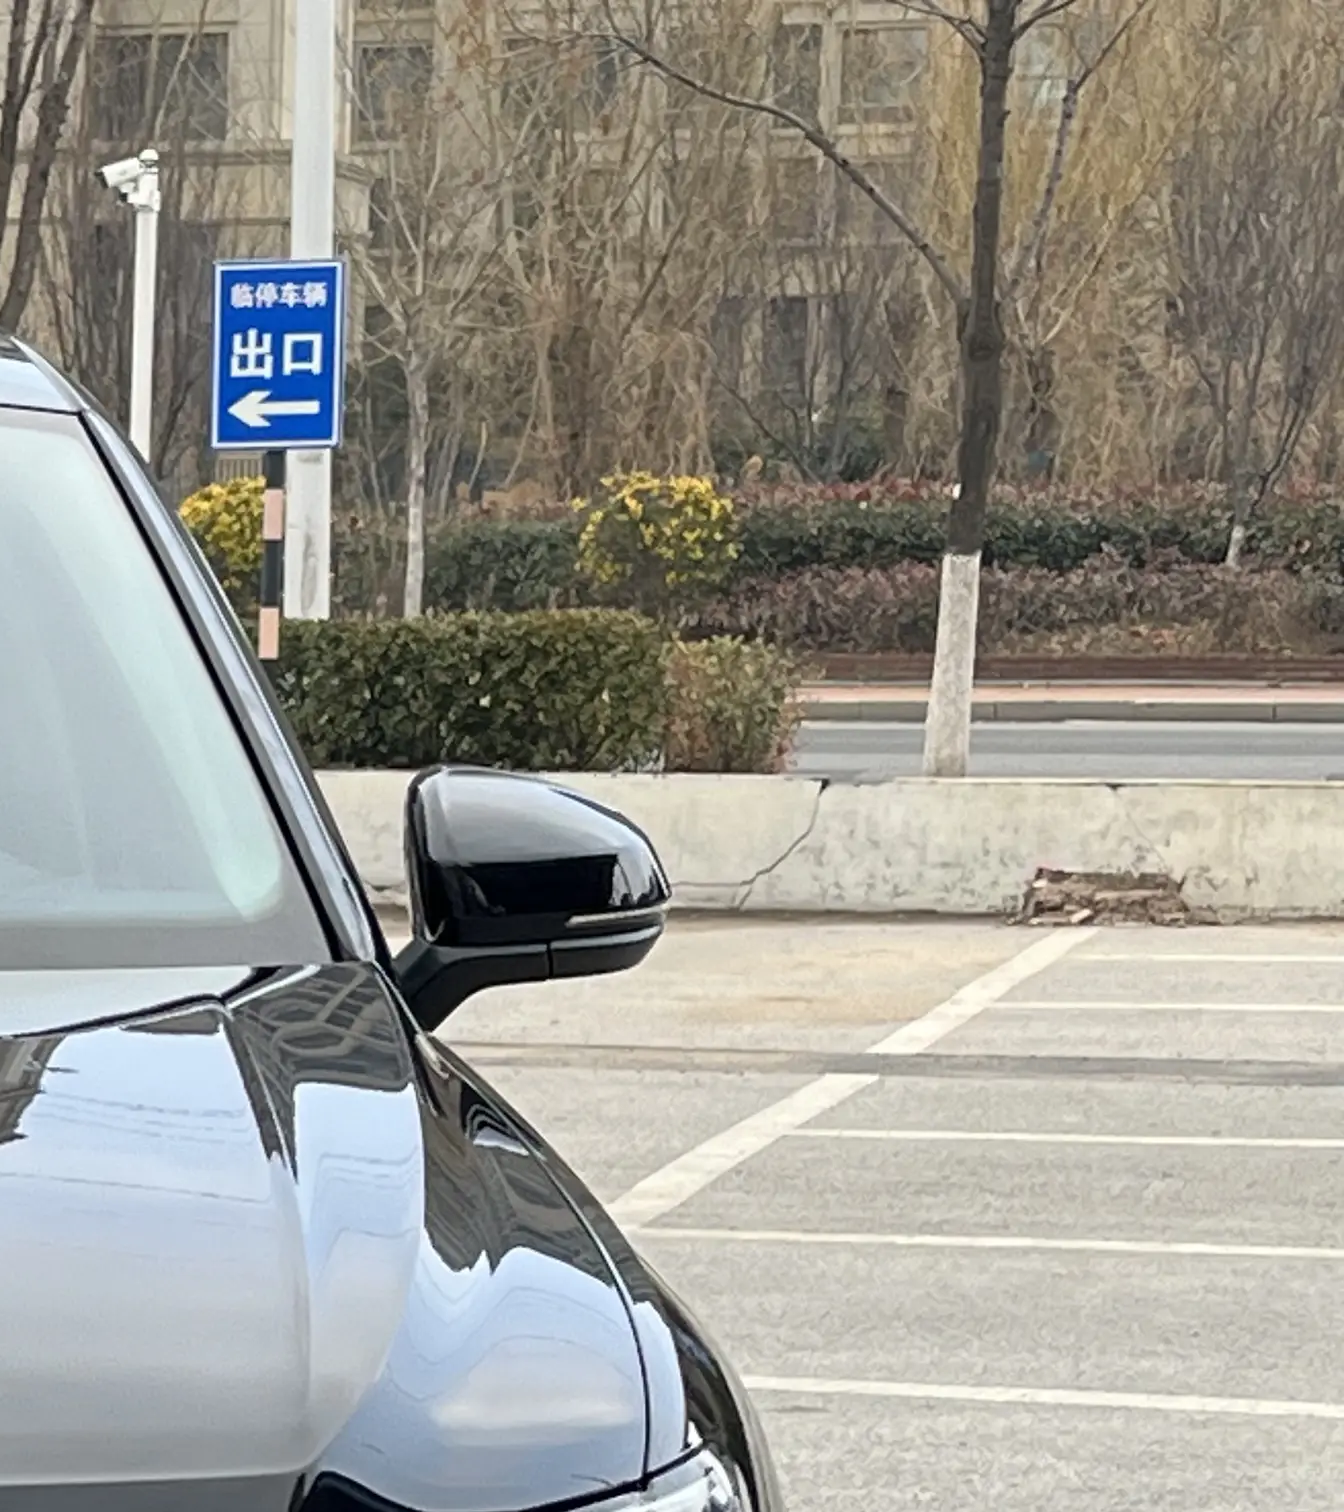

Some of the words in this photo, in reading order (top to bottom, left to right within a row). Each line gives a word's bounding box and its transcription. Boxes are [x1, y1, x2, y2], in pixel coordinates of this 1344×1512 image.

[229, 281, 328, 309] 临停车辆
[229, 327, 324, 380] 出口
